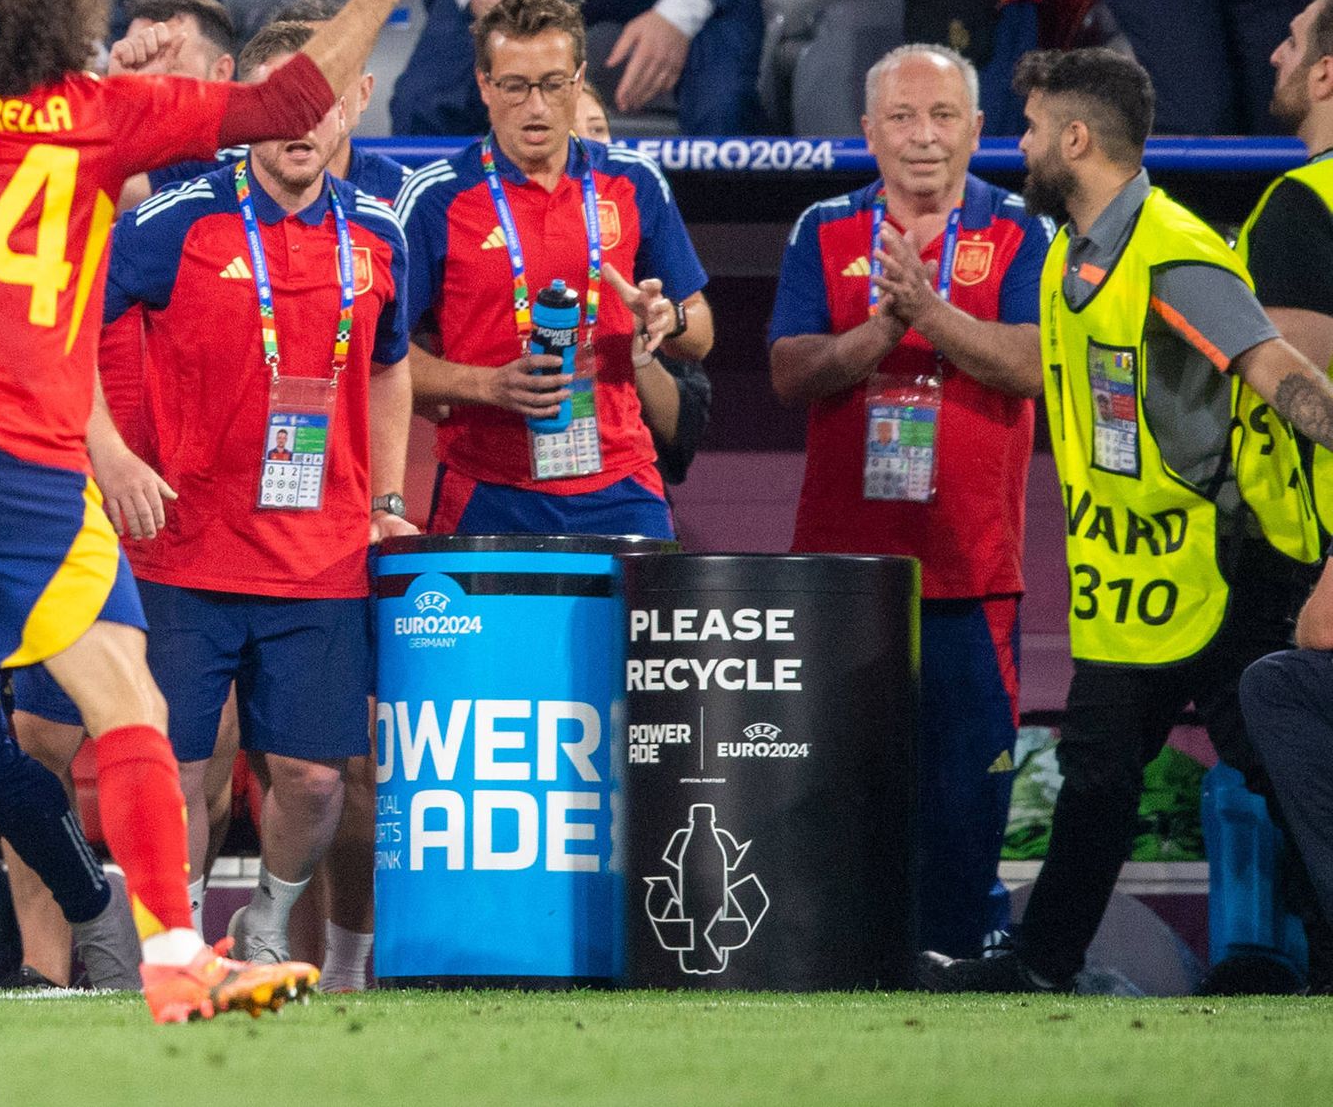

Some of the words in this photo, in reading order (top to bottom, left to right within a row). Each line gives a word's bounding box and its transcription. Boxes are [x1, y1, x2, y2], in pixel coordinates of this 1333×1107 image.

[537, 328, 573, 340] POWER
[550, 335, 572, 347] ADE
[415, 593, 449, 611] UEFA
[1073, 563, 1179, 627] 310
[394, 615, 483, 636] EURO2024
[630, 608, 795, 642] PLEASE
[409, 637, 457, 649] GERMANY
[626, 657, 803, 692] RECYCLE
[376, 698, 602, 783] OWER
[628, 723, 691, 744] POWER
[744, 724, 780, 742] UEFA
[628, 744, 660, 764] ADE
[717, 742, 809, 758] EURO2024
[409, 789, 601, 873] ADE
